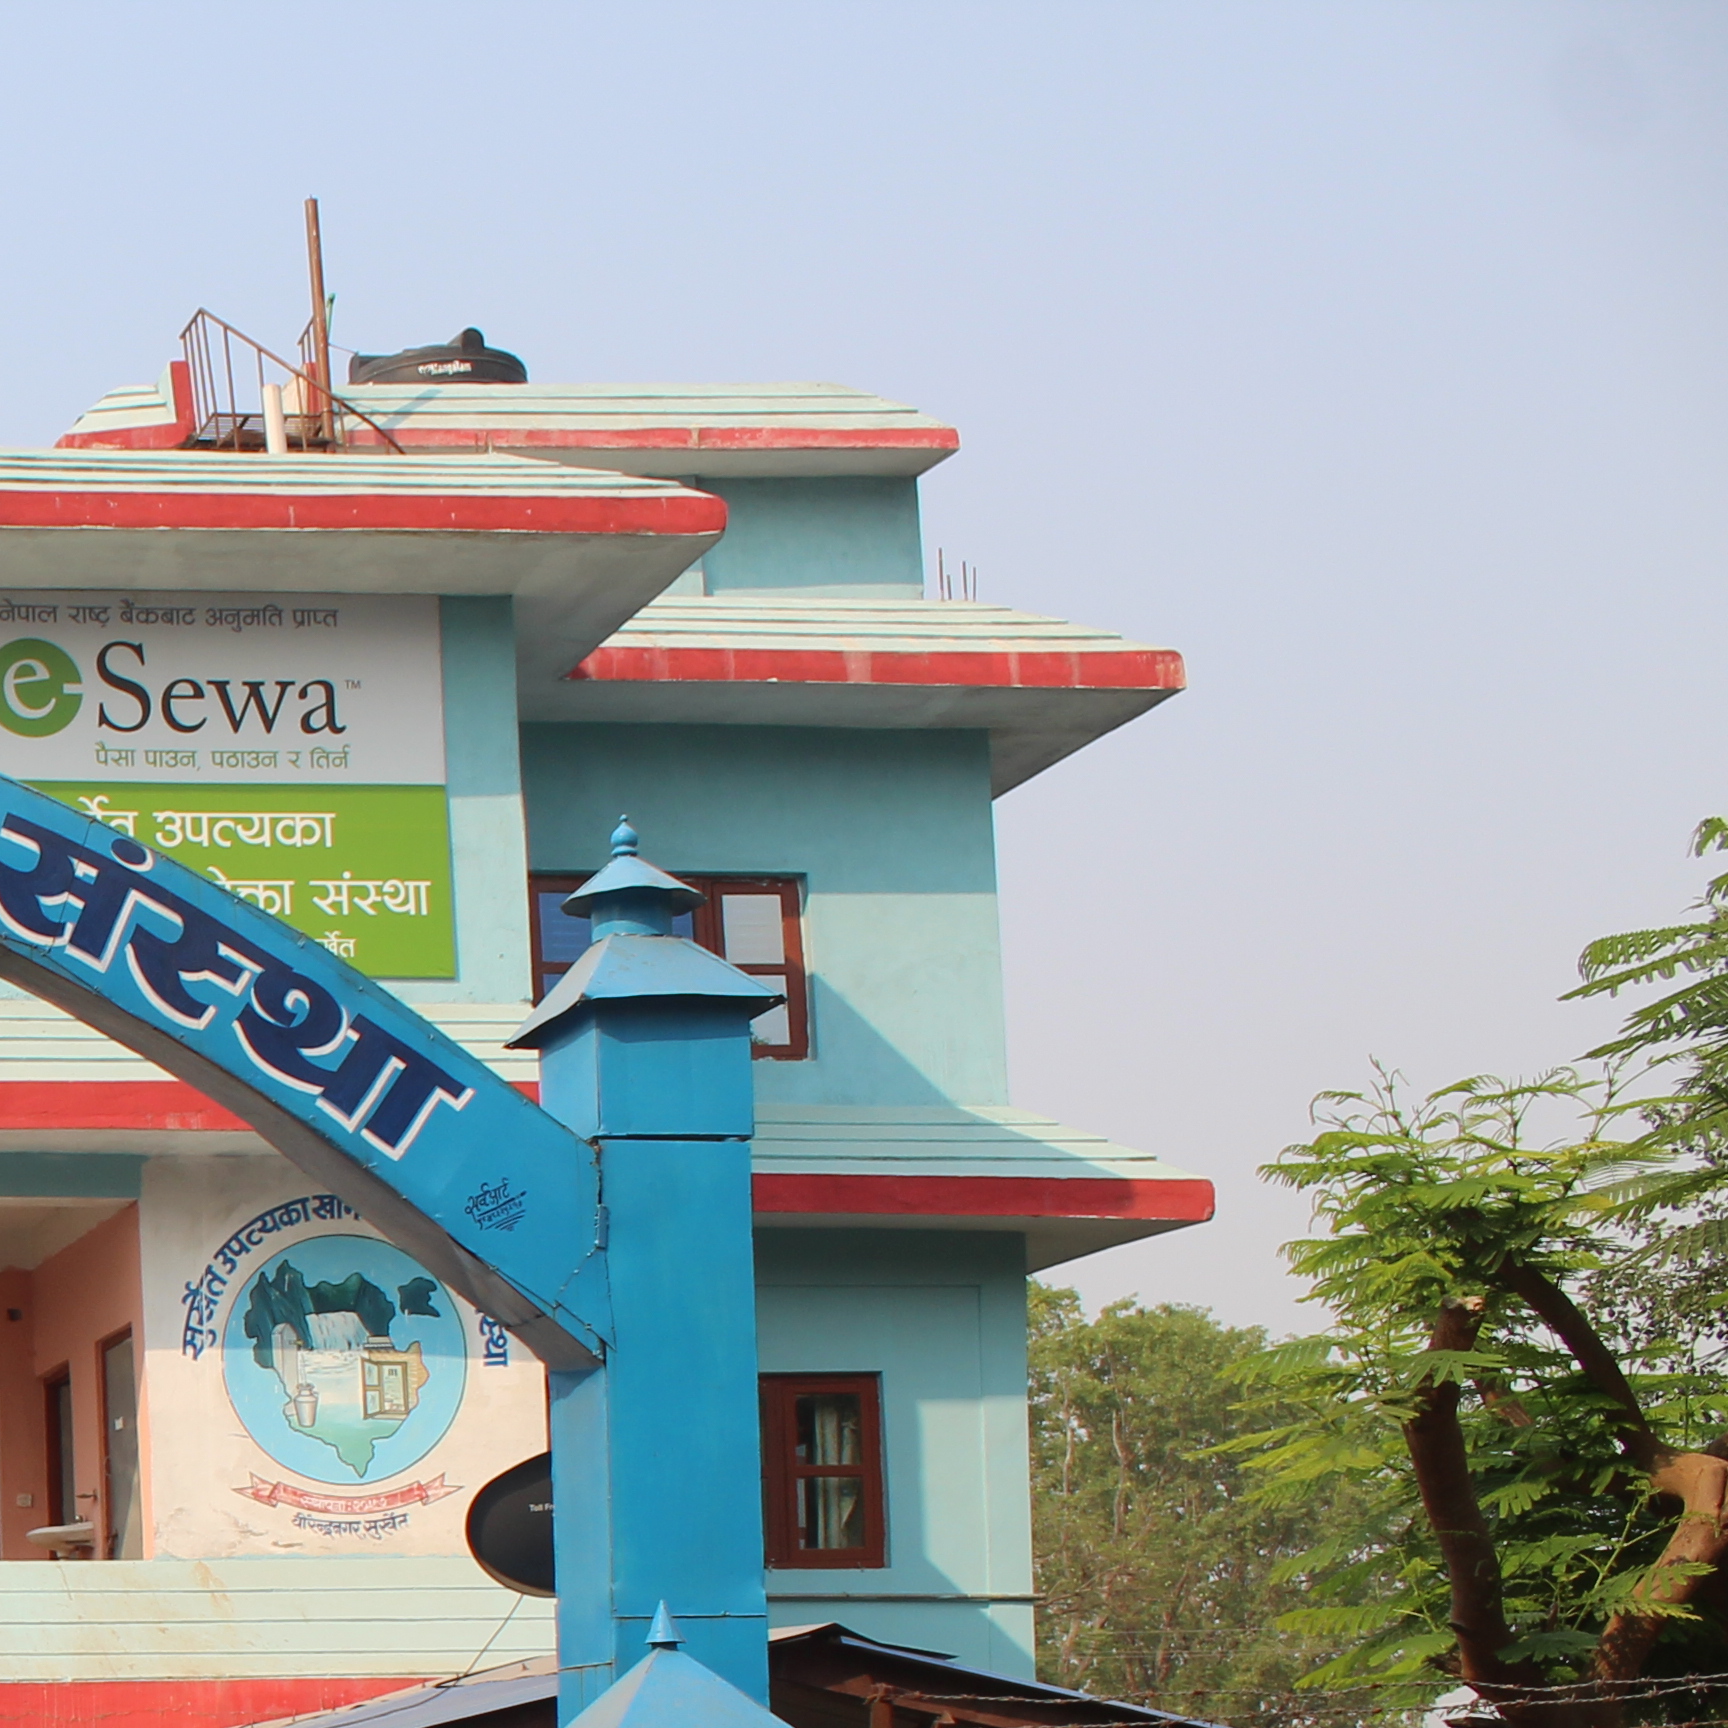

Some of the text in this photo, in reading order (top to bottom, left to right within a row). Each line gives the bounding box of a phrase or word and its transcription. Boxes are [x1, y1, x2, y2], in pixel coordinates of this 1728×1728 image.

[67, 604, 111, 629] राष्ट्र
[120, 598, 196, 627] बैंकबाट
[205, 603, 284, 632] अनुमति
[291, 606, 339, 630] प्राप्त
[94, 741, 136, 768] पैसा
[211, 747, 279, 770] पठाउन
[287, 749, 302, 770] र
[310, 744, 352, 770] तिर्न
[152, 810, 337, 849] उपत्यका
[308, 870, 432, 917] संस्था
[181, 1263, 229, 1362] सुर्खेत
[212, 1196, 313, 1276] उपत्यका
